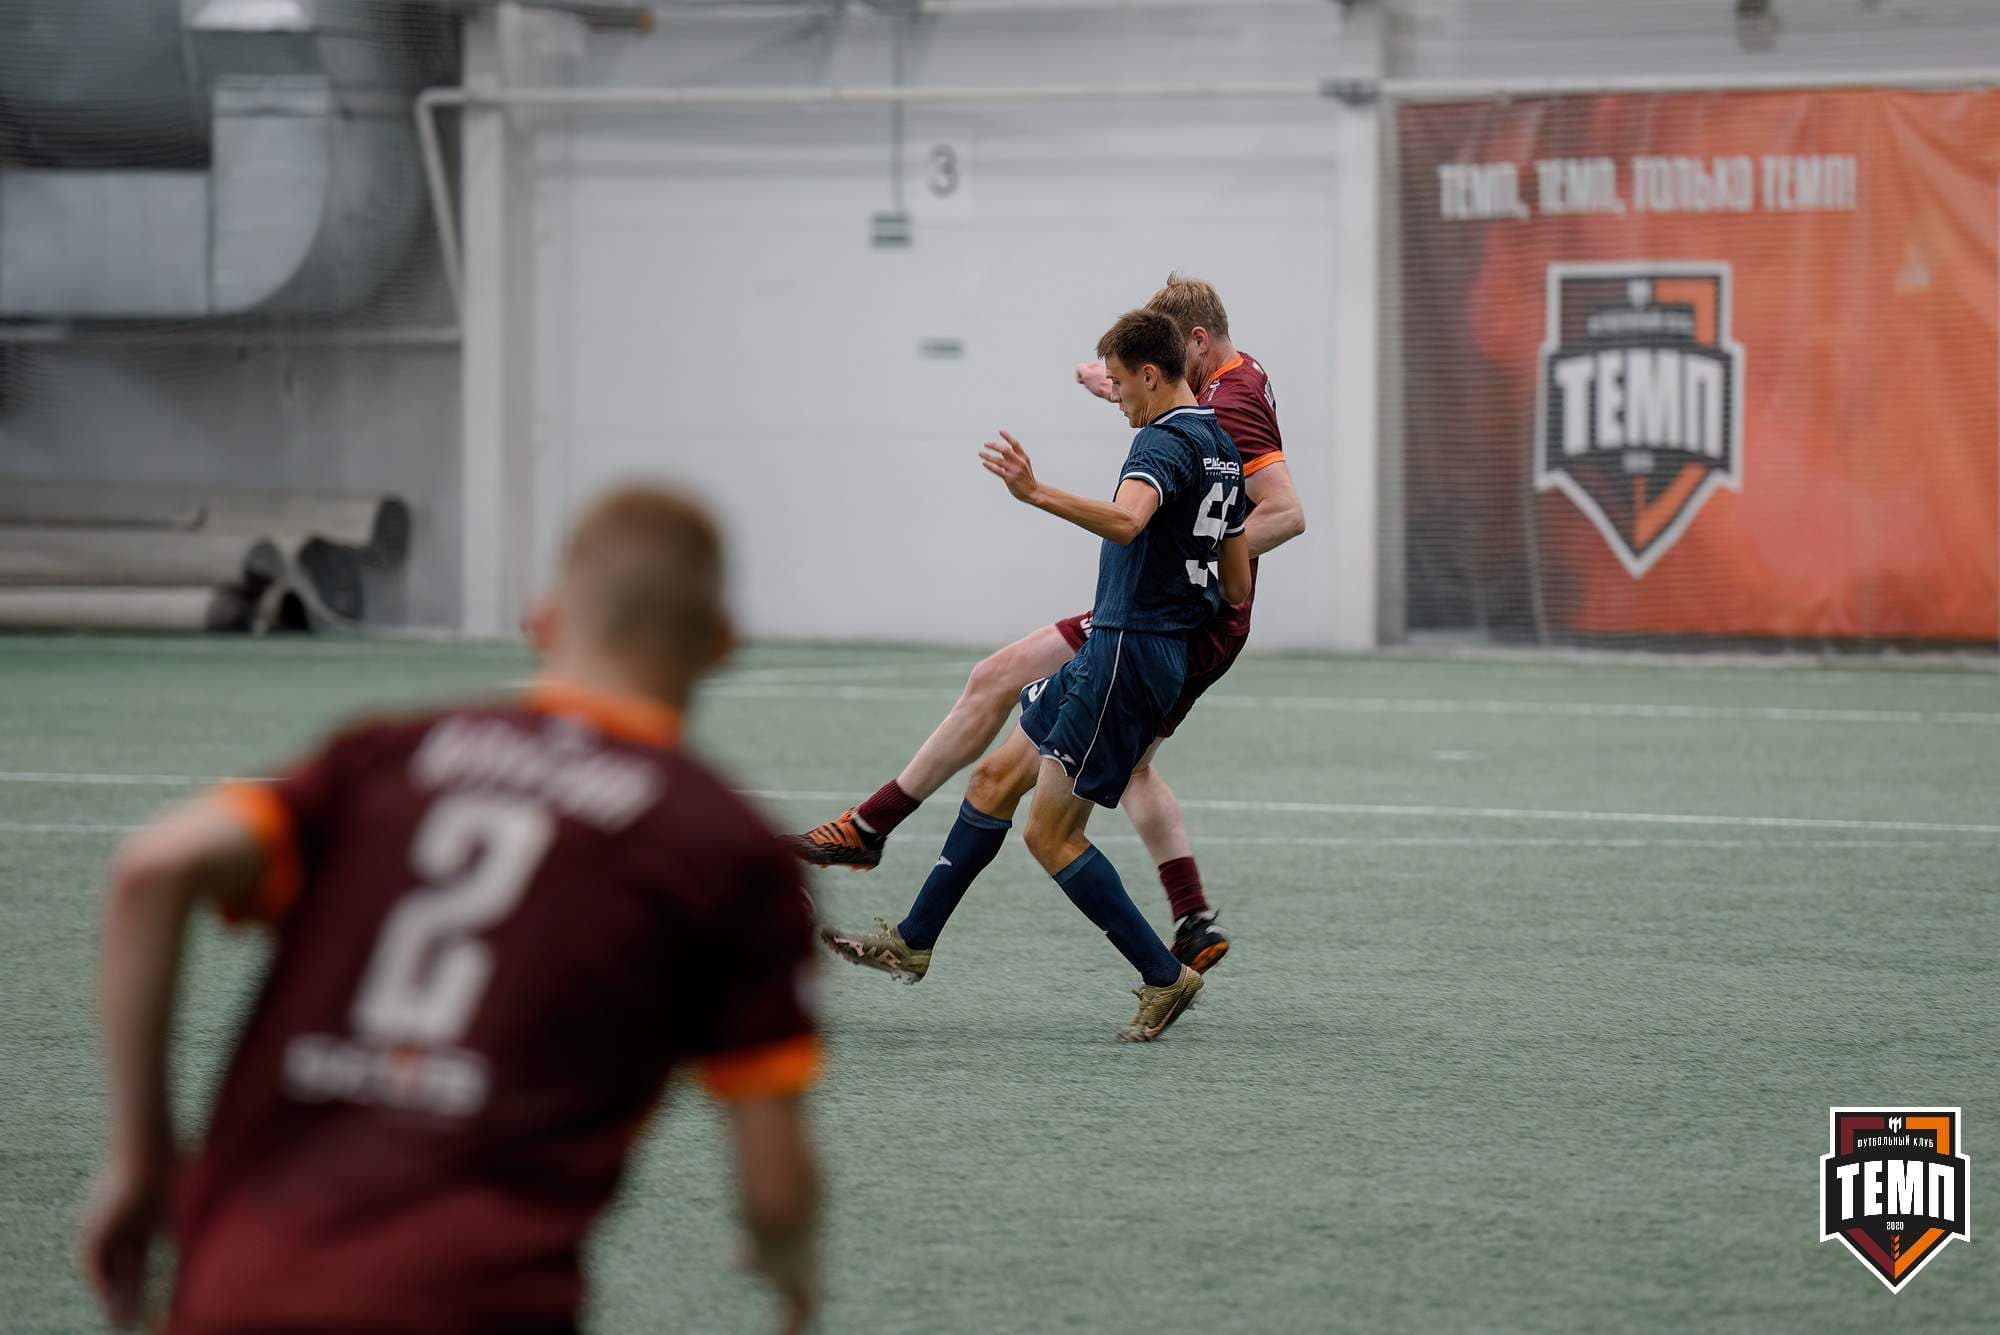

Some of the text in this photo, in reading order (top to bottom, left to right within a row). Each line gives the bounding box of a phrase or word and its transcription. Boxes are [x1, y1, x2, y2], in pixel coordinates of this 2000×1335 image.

[928, 144, 959, 198] 3
[1633, 154, 1754, 213] ТОЛЬКО
[1762, 153, 1857, 212] ТЕМП!
[1555, 349, 1725, 457] ТЕМП
[353, 794, 555, 1044] 2
